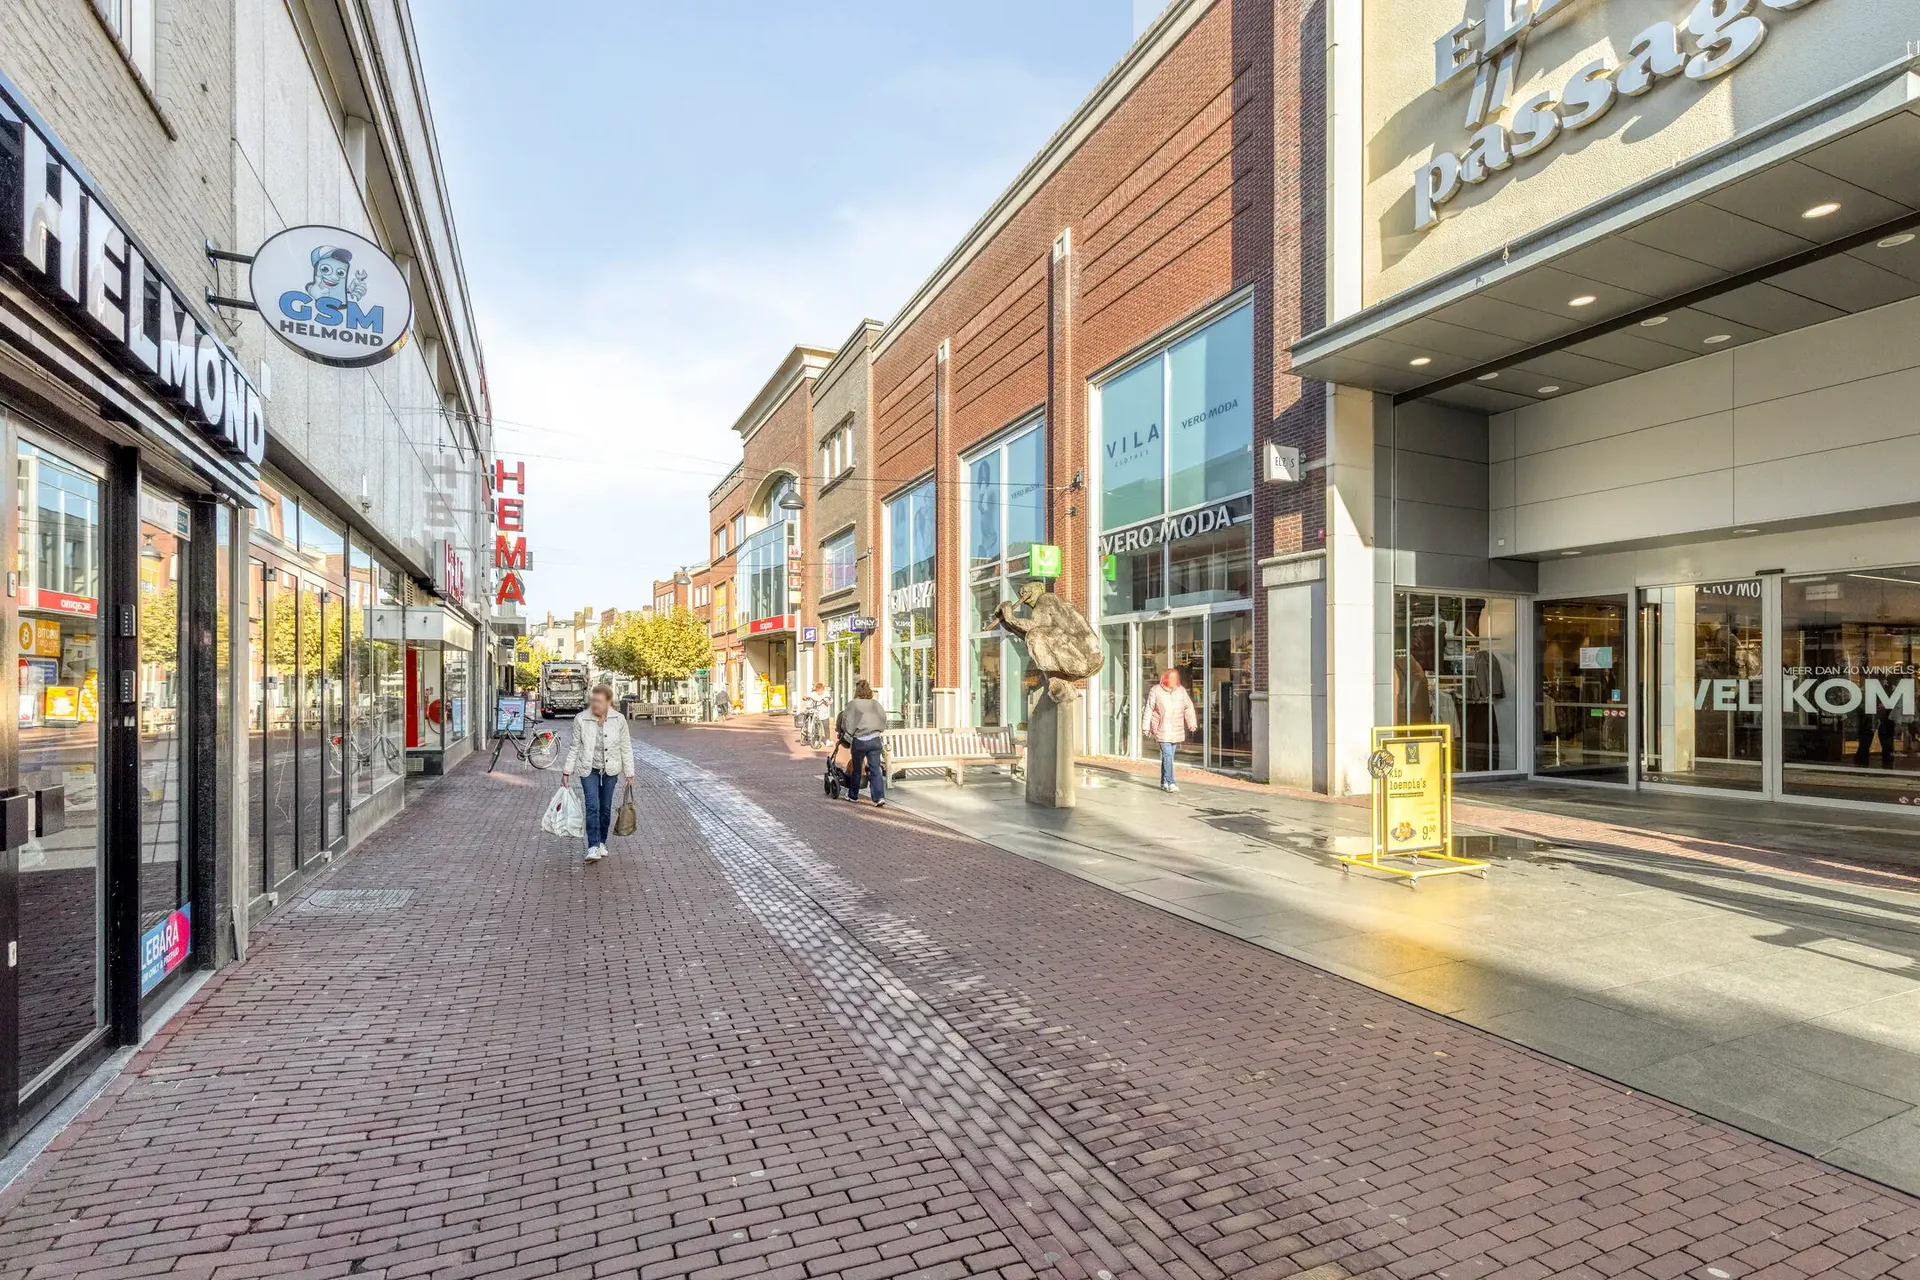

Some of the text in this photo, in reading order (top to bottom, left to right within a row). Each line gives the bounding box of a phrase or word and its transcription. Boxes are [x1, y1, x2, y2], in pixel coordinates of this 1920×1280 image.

[1413, 0, 1812, 233] passag
[23, 121, 266, 466] HELMOND
[278, 290, 385, 335] GSM
[279, 319, 384, 347] HELMOND
[1181, 398, 1239, 429] VERO MODA
[1106, 422, 1161, 459] VILA
[1275, 456, 1295, 469] ELZS
[495, 458, 528, 607] HEMA
[1100, 523, 1155, 556] VERO
[854, 619, 875, 627] ONLY
[1783, 665, 1915, 675] MEER DAN 40 WINKELS
[1389, 778, 1427, 791] loempia's
[141, 920, 180, 971] LEBARA
